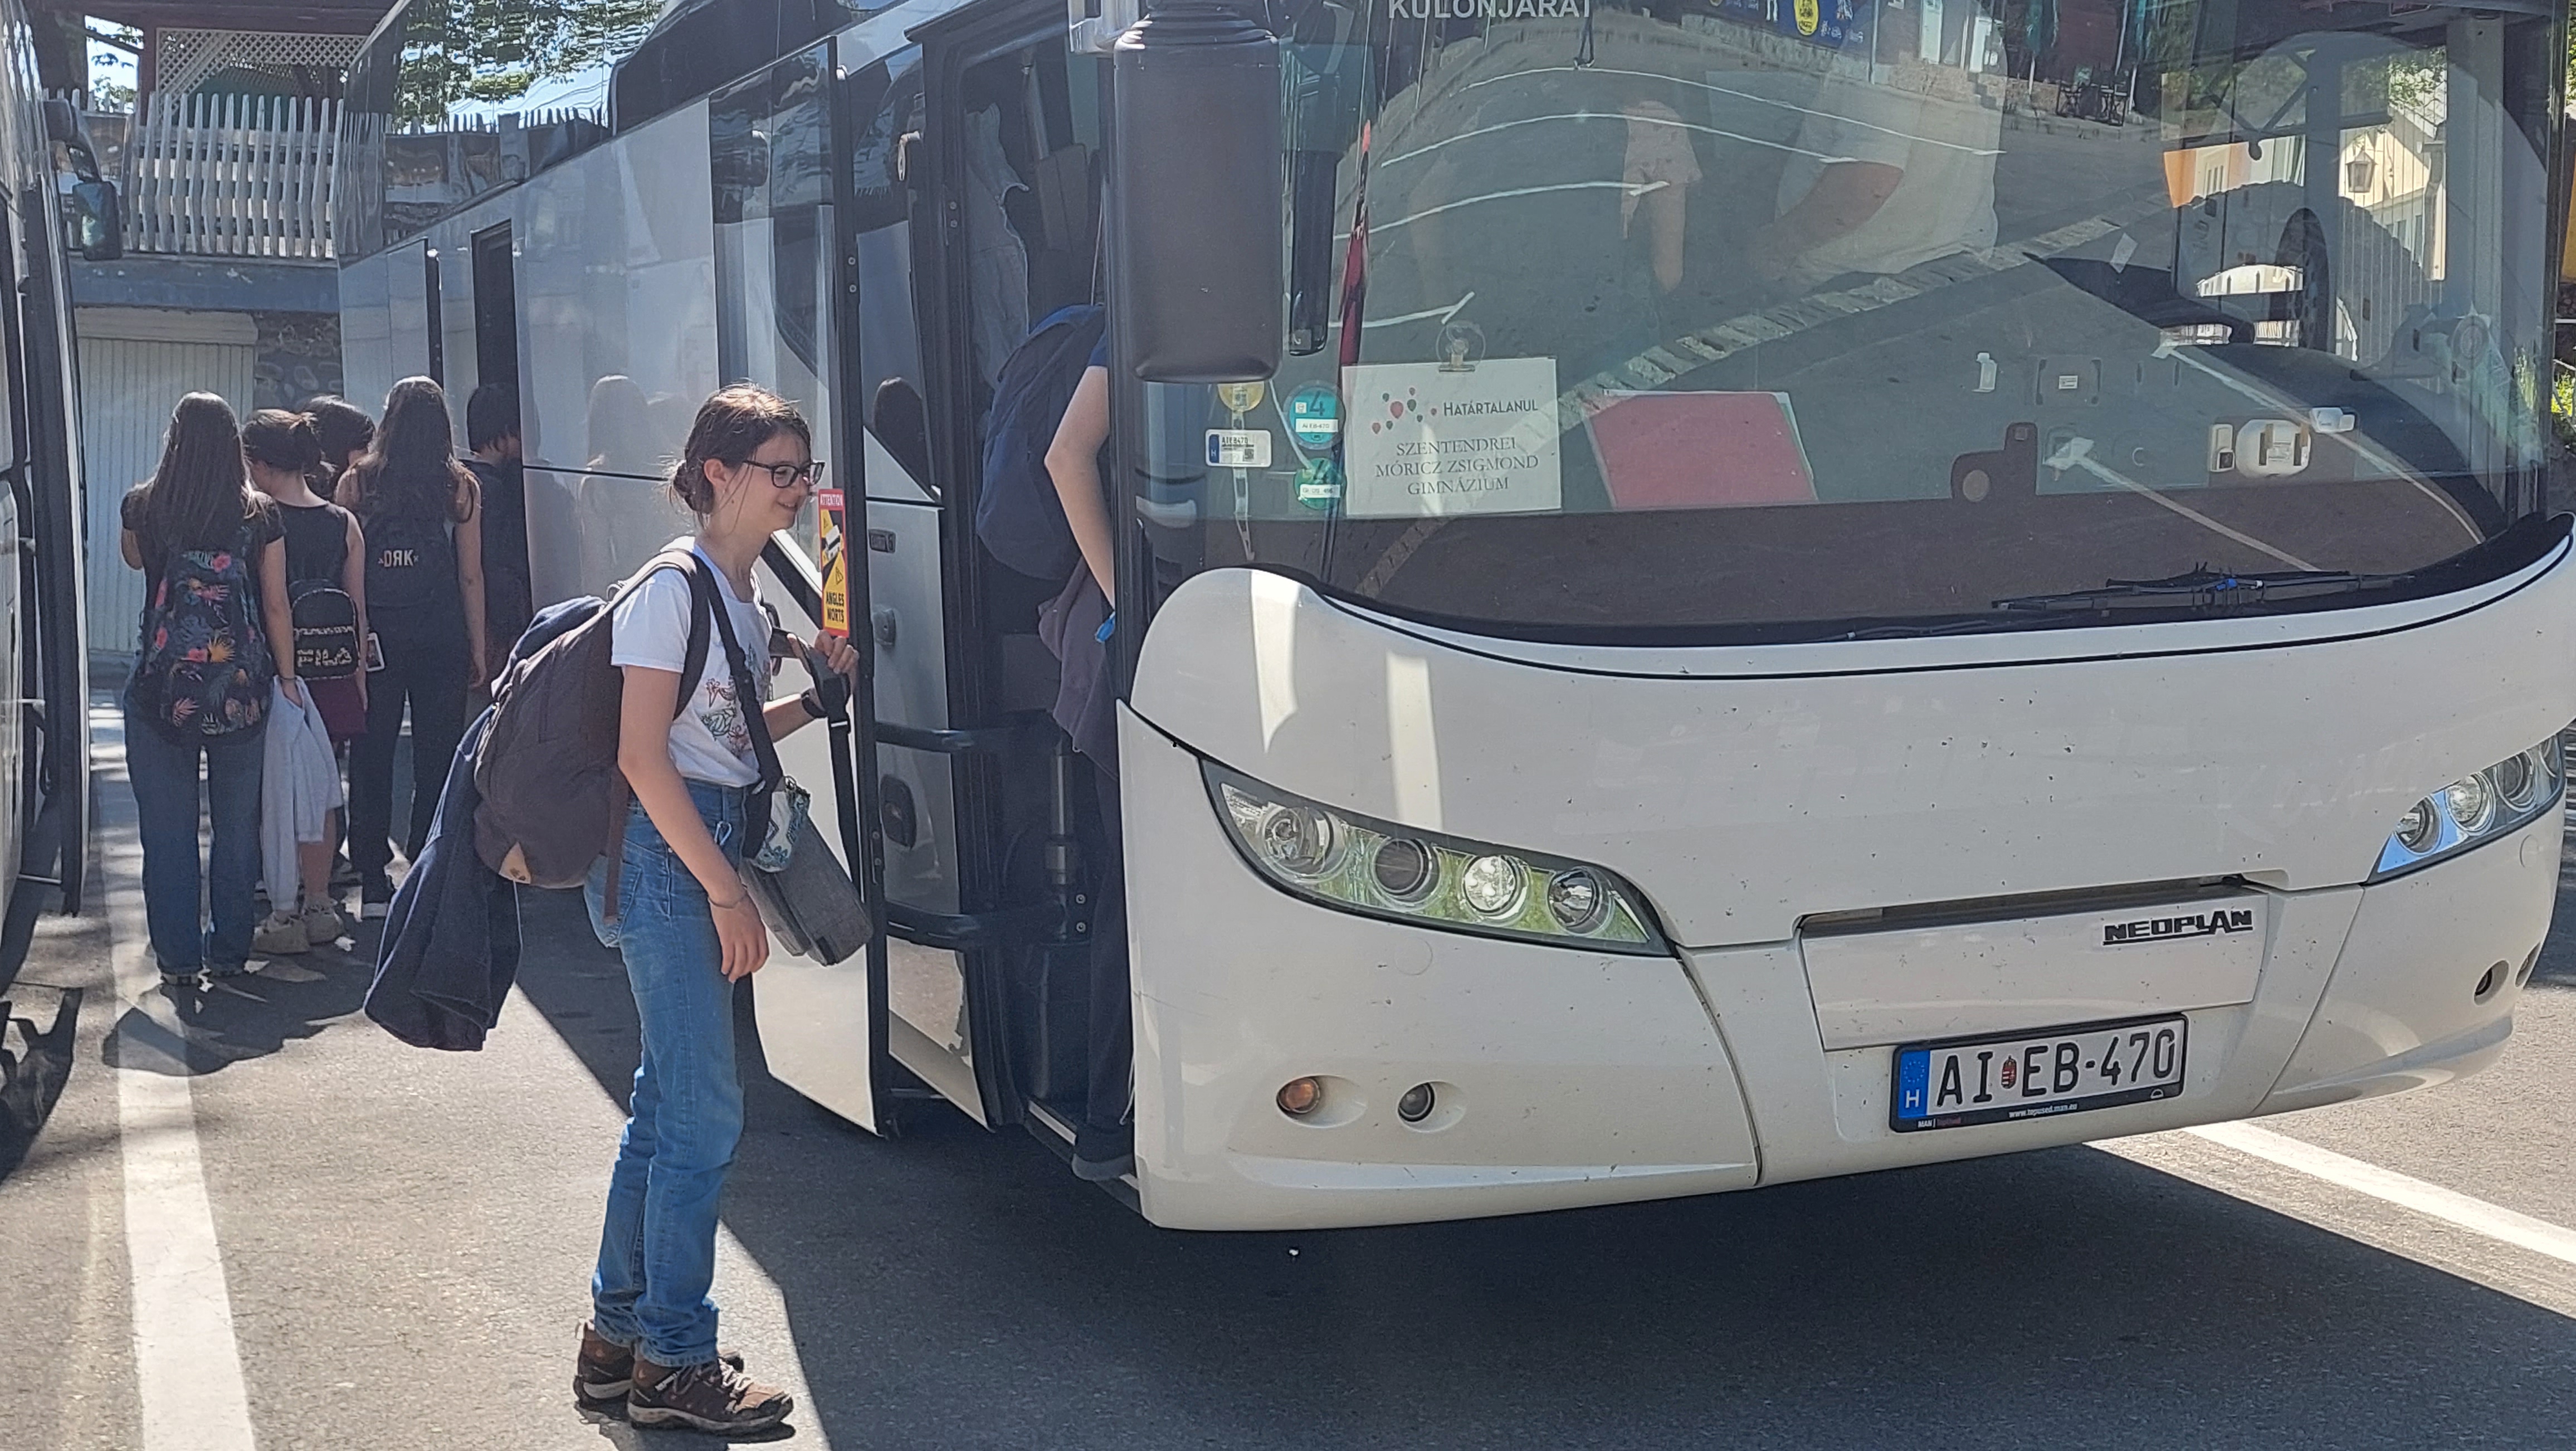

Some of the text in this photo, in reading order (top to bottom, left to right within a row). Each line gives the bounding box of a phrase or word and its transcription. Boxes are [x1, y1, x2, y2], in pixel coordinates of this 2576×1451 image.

[1309, 390, 1325, 416] 4
[1397, 436, 1516, 456] SZENTENDREI
[1375, 455, 1539, 478] MÓRICZ ZSIGMOND
[1407, 476, 1509, 495] GIMNÁZIUM
[826, 591, 845, 607] ANGLES
[827, 608, 845, 624] MORTS
[2104, 909, 2253, 944] NEOPLAN
[1936, 1029, 2177, 1107] AI EB-470
[1904, 1089, 1920, 1109] H
